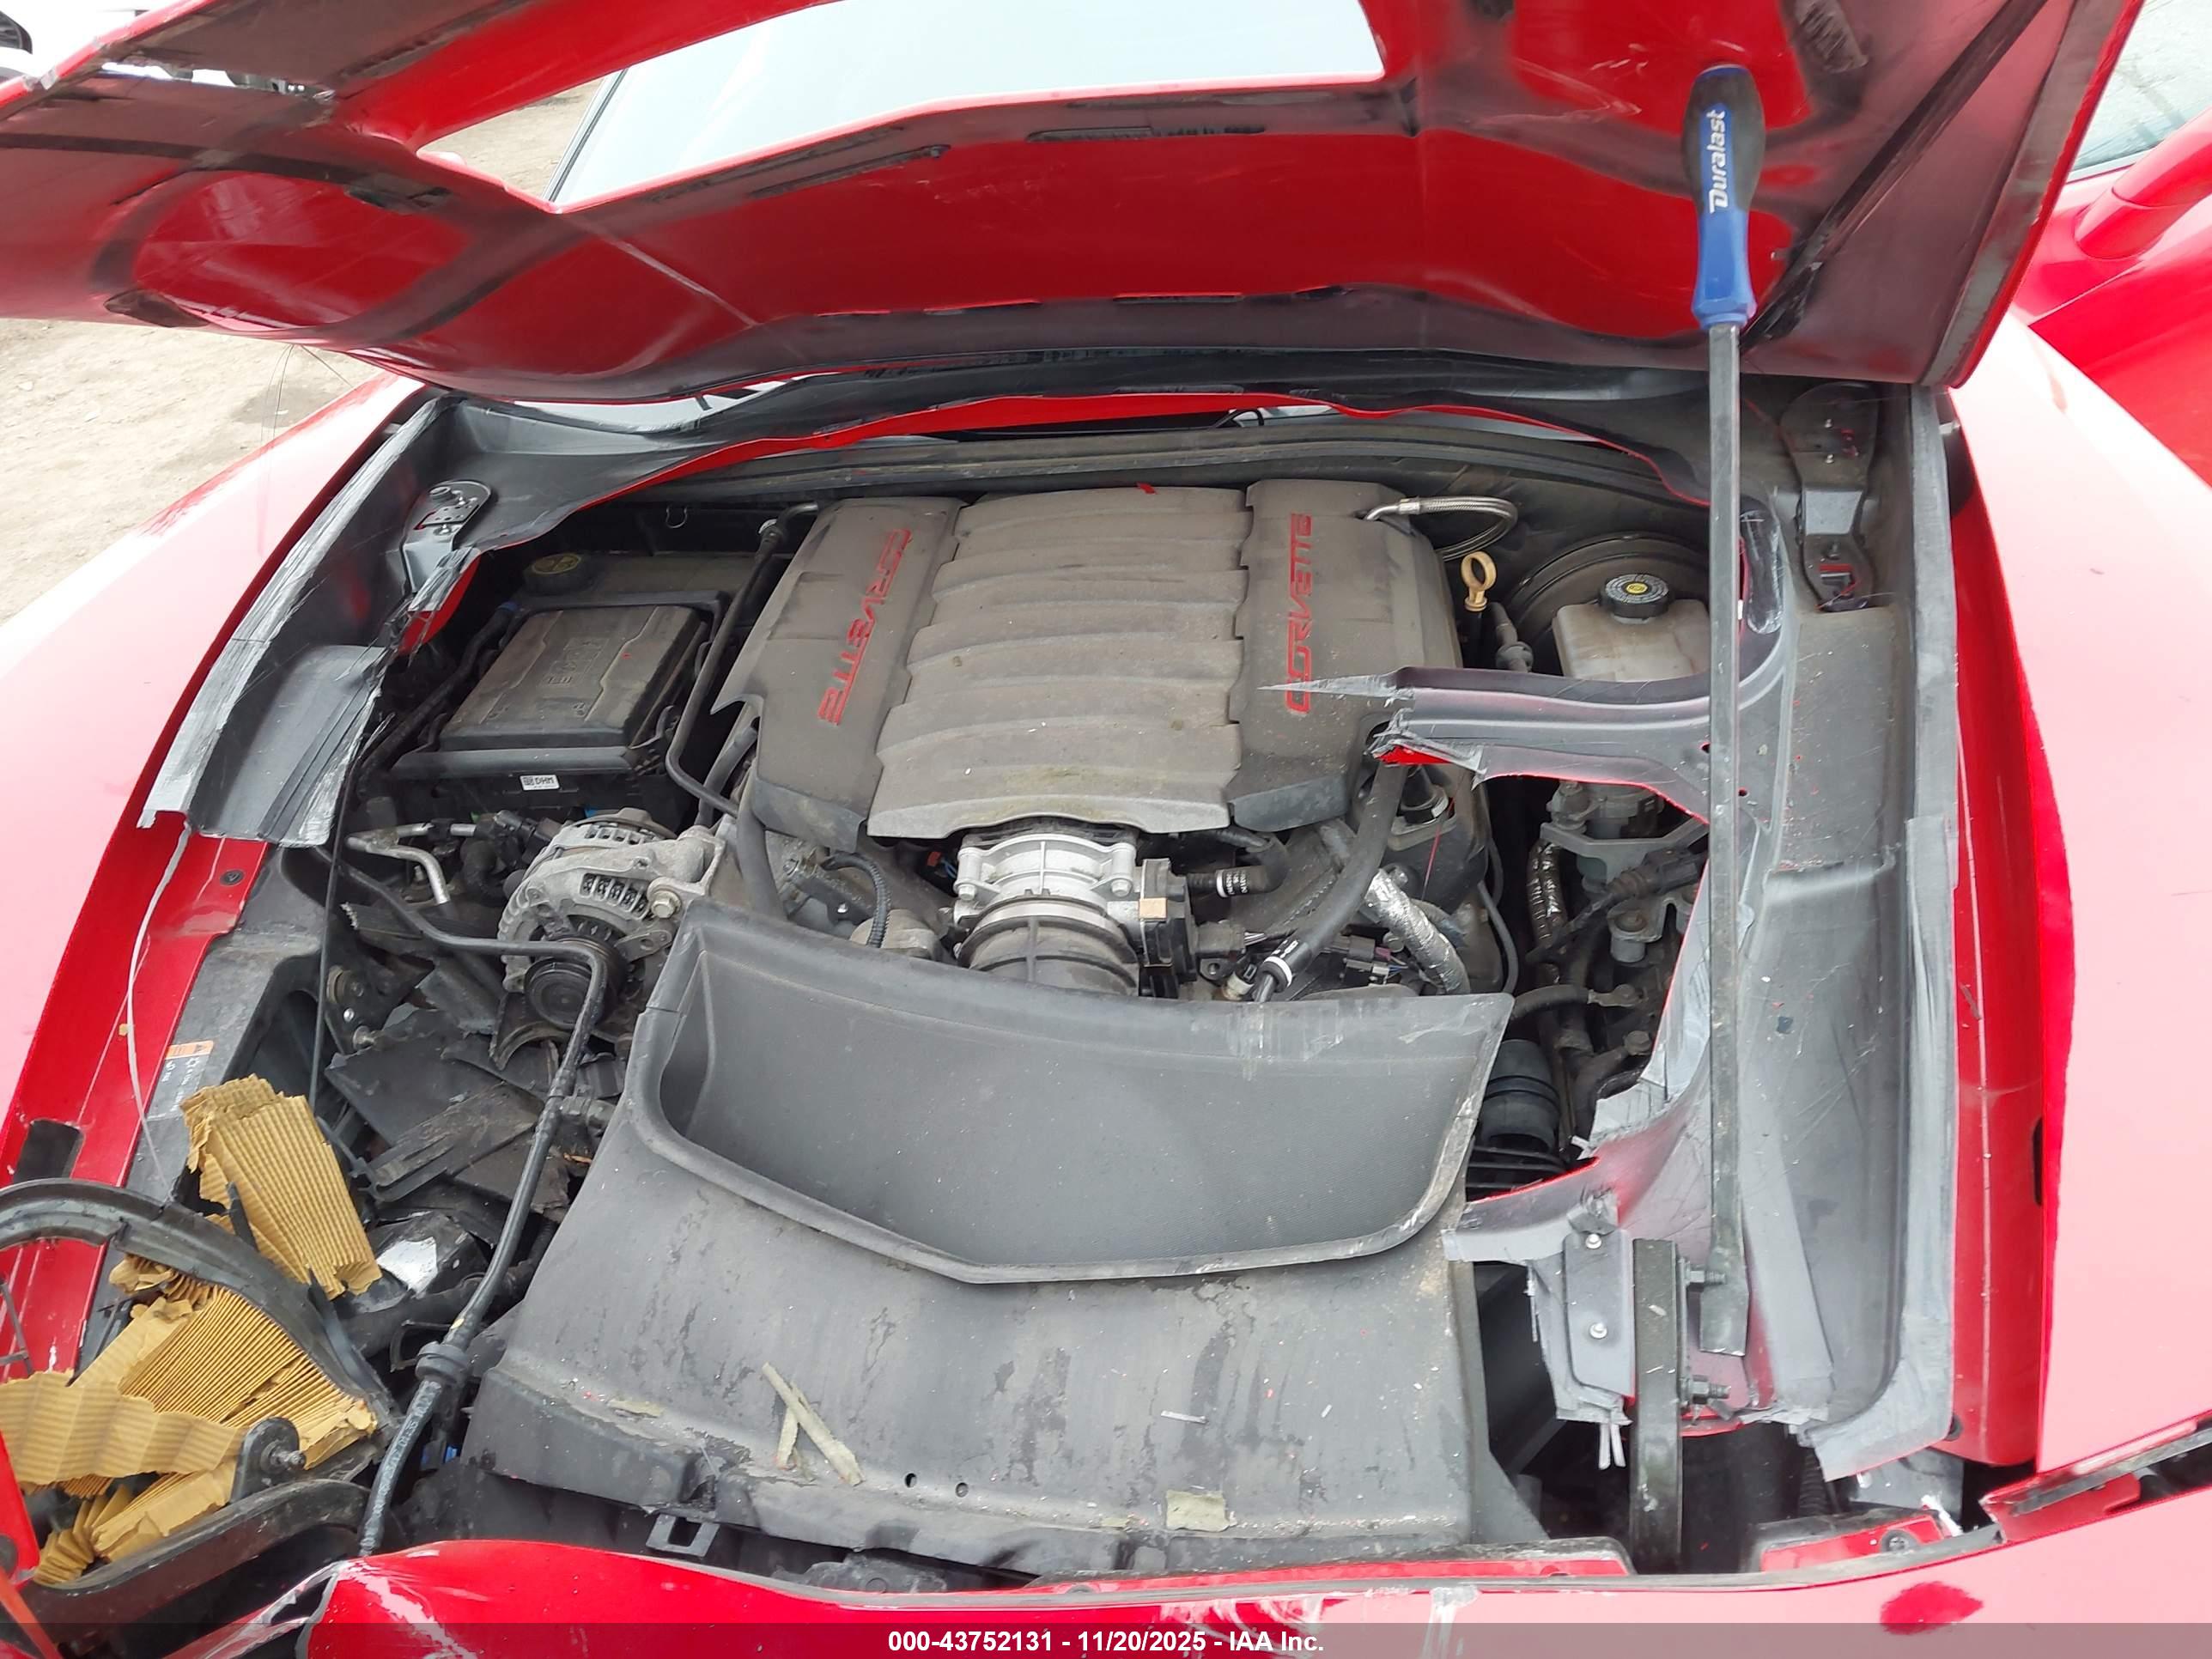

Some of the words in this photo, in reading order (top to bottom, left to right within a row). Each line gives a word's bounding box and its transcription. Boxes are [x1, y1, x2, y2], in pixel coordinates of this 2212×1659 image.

[1705, 109, 1729, 214] Duralast
[818, 527, 912, 726] CORVETTE
[1285, 513, 1313, 714] CORVETTE
